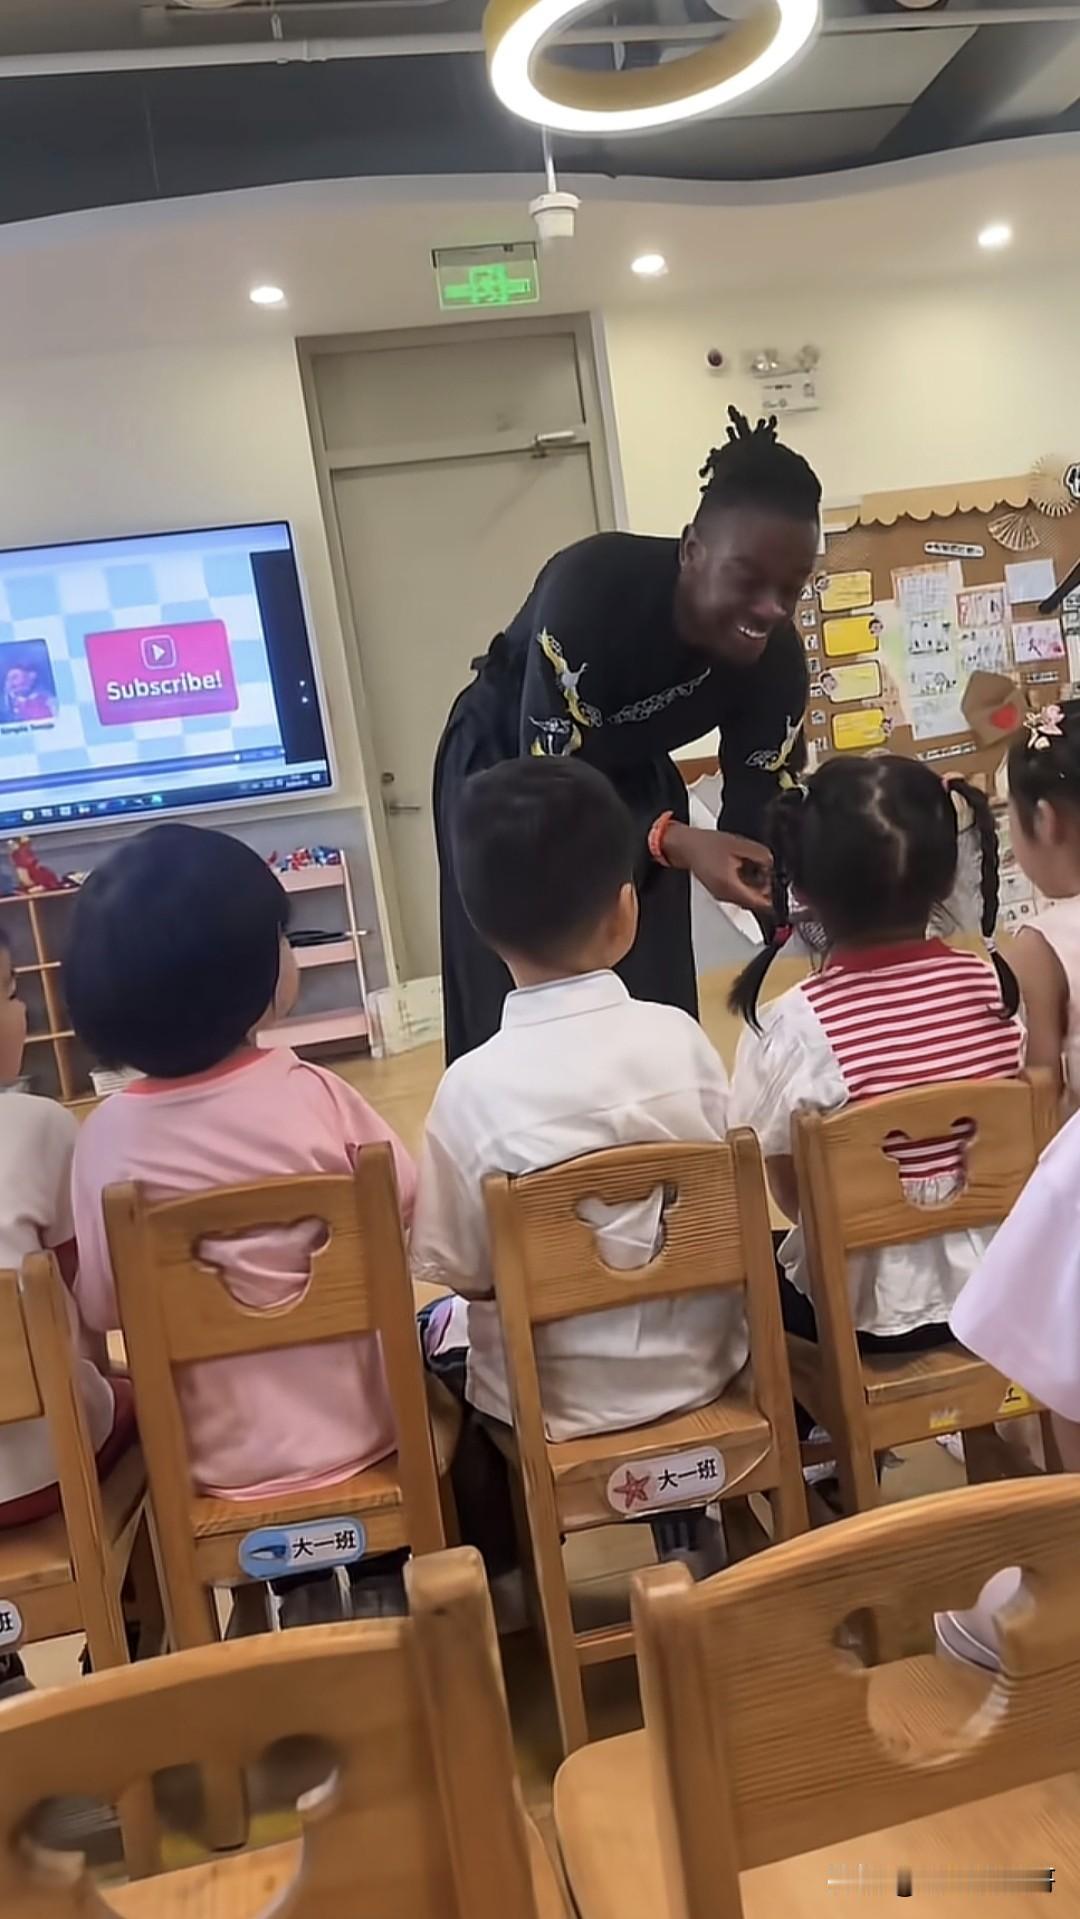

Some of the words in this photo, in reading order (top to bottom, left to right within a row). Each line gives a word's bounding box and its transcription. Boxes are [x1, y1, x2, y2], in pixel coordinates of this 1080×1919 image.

[106, 670, 222, 701] Subscribe!
[657, 1458, 718, 1491] 大一班
[292, 1530, 357, 1559] 大一班
